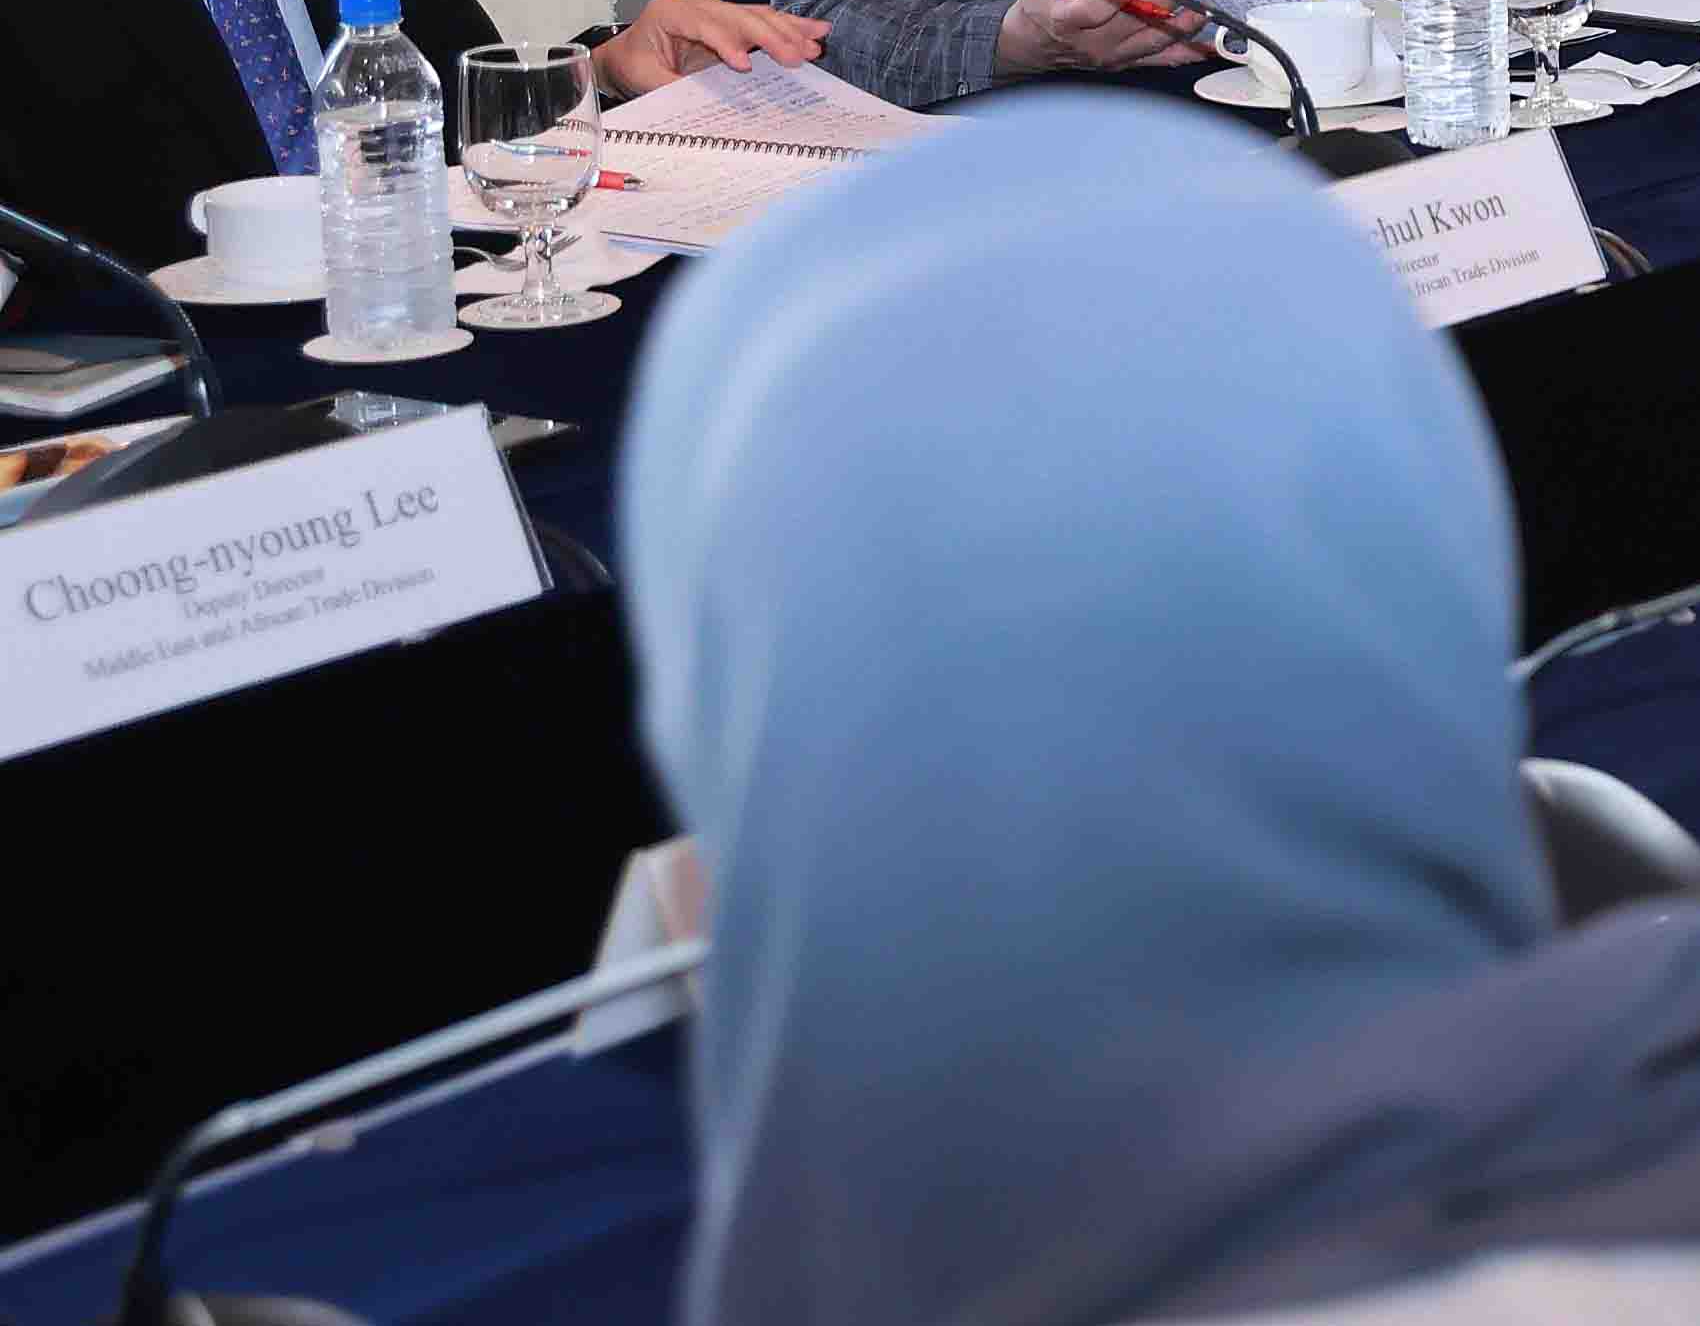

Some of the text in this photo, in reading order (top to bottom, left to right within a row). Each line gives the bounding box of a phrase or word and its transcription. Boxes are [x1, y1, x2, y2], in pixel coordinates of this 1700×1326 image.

[1371, 194, 1506, 249] hul Kwon
[24, 485, 440, 622] Choong-nyoung Lee
